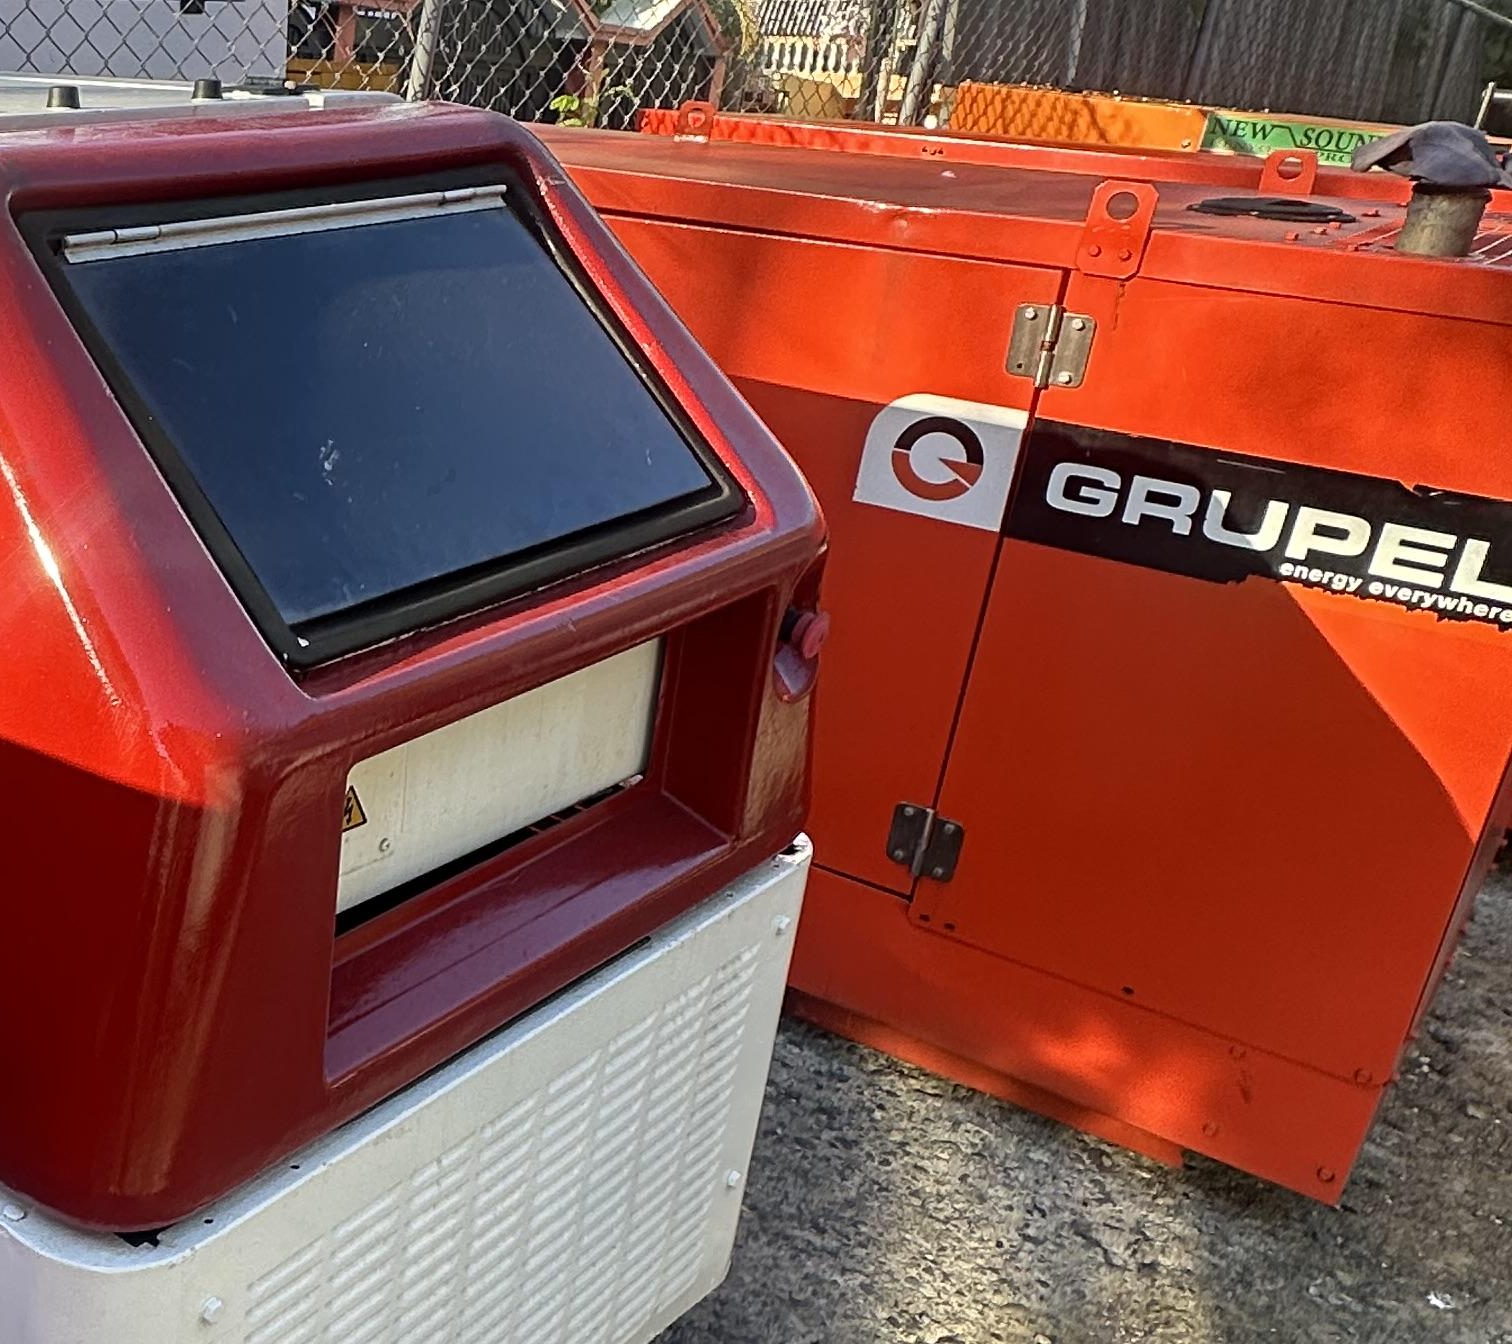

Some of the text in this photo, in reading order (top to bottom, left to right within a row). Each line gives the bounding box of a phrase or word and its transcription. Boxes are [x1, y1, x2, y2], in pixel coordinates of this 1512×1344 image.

[1210, 117, 1383, 152] NEW SOUN
[1045, 462, 1512, 604] GRUPEL
[1280, 562, 1512, 623] energy everywhere
